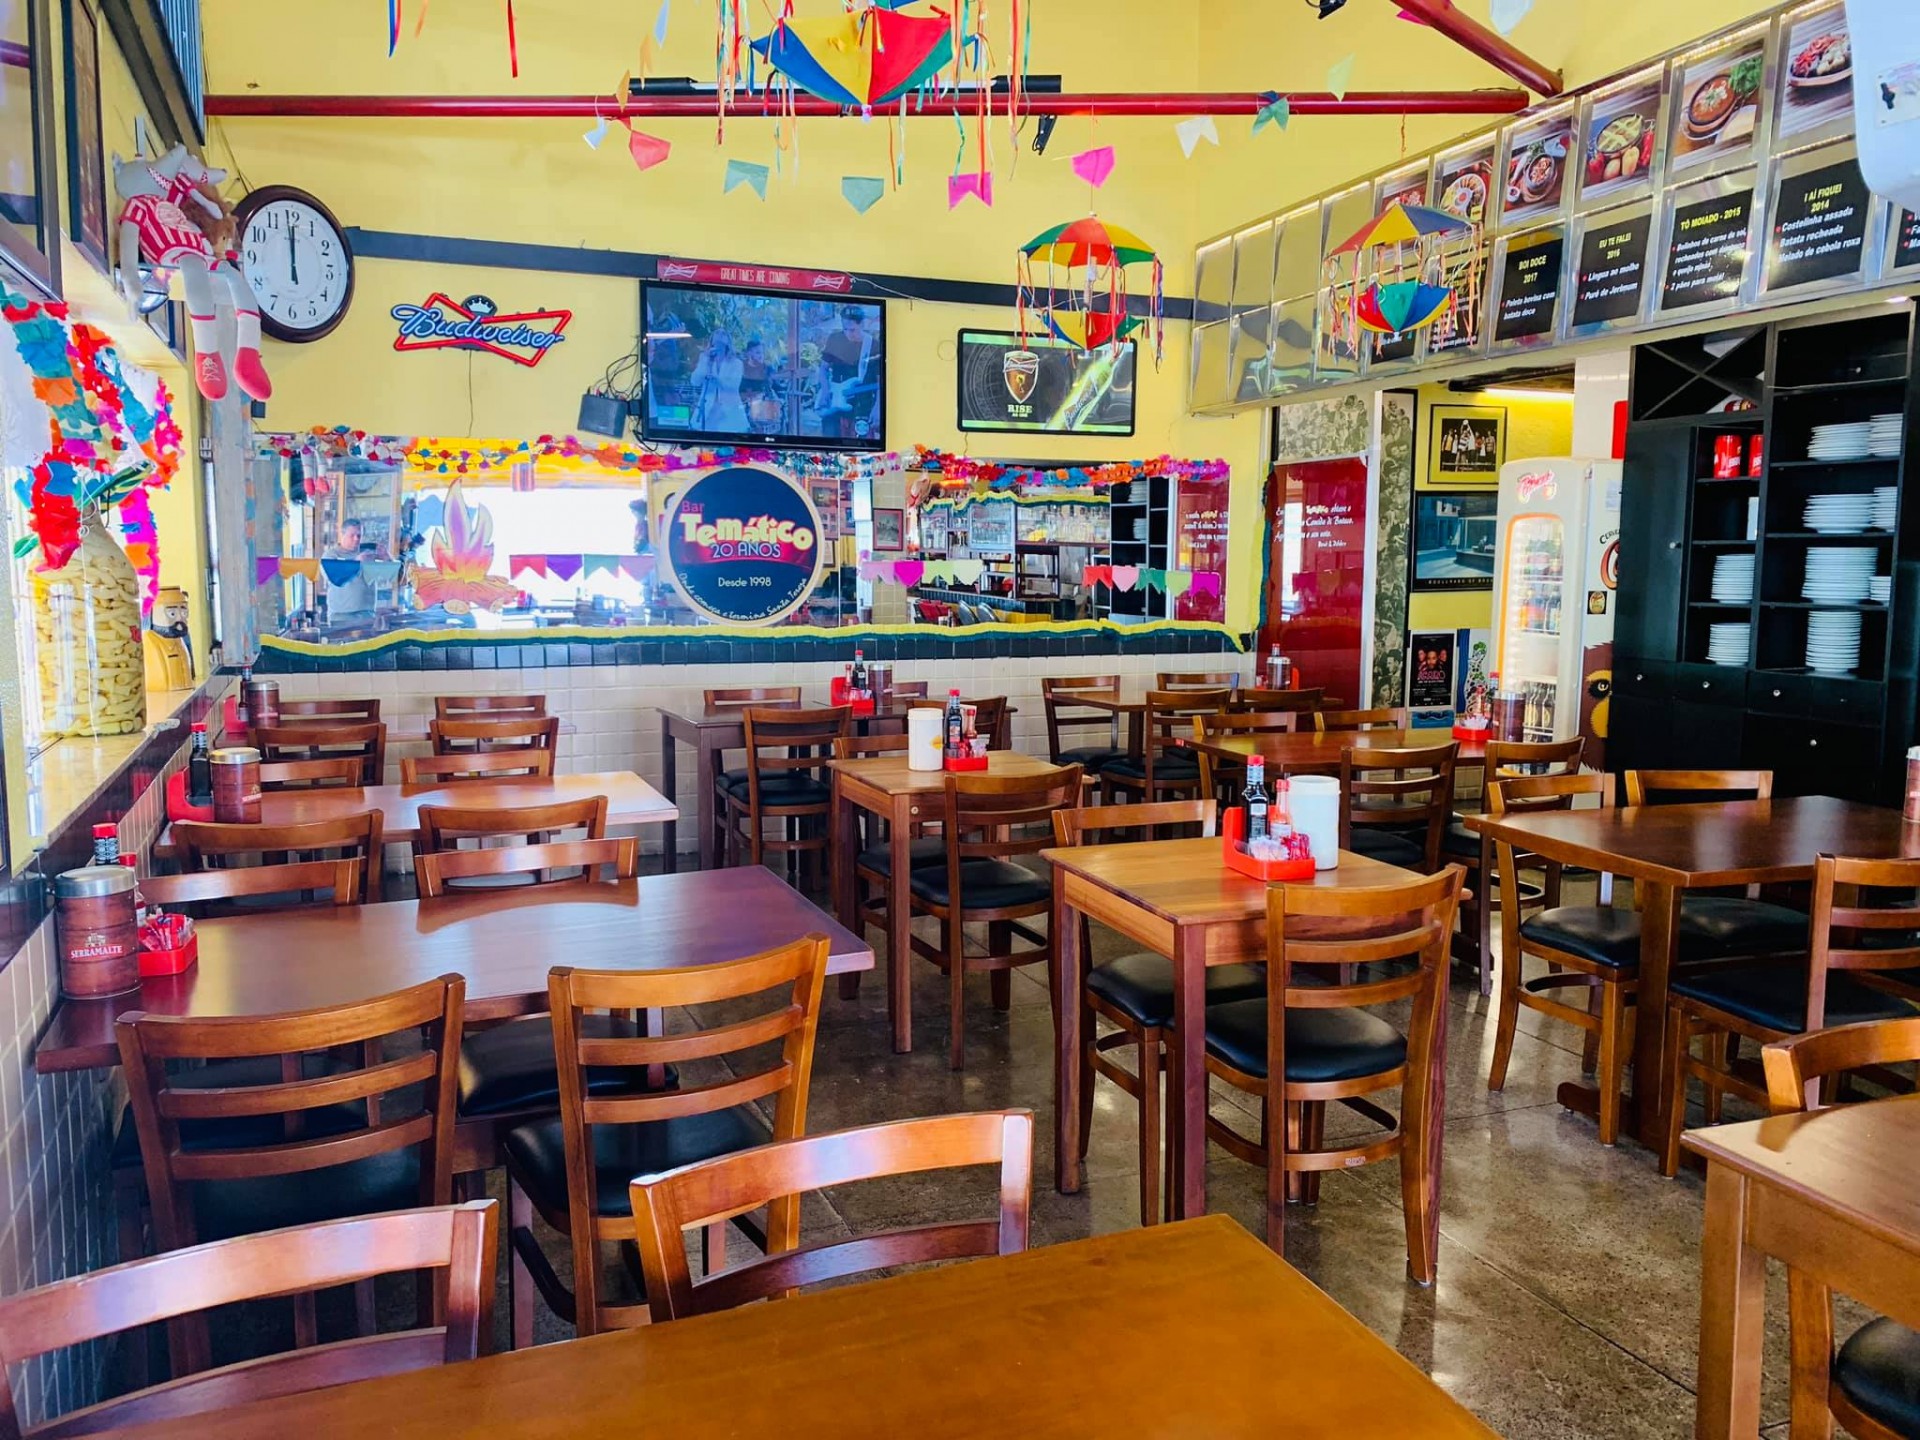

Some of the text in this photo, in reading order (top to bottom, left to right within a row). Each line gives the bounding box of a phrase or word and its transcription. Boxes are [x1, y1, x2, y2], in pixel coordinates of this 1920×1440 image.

[1818, 183, 1842, 198] FIQUEI
[1811, 199, 1830, 213] 2014
[268, 211, 278, 229] 11
[1691, 213, 1719, 228] MOIADO
[1724, 207, 1741, 219] 2015
[1782, 206, 1854, 232] Costelinha assada
[252, 226, 266, 243] 10
[1780, 225, 1843, 247] Batata recheada
[322, 240, 330, 256] 2
[1805, 247, 1814, 256] de
[1815, 241, 1841, 255] cebola
[1842, 237, 1861, 248] roxa
[248, 250, 257, 265] 9
[1530, 255, 1547, 268] DOCE
[326, 263, 333, 281] 3
[721, 268, 736, 280] GREAT
[739, 269, 754, 282] TIMES
[769, 271, 790, 285] COMING
[1523, 272, 1538, 284] 2017
[270, 294, 278, 310] 7
[320, 286, 327, 302] 4
[1542, 291, 1556, 300] com
[289, 303, 297, 320] 6
[309, 301, 316, 317] 5
[1503, 308, 1536, 320] batata doce
[391, 304, 565, 348] Budweiser
[1008, 404, 1032, 413] RISE
[682, 501, 704, 512] Bar
[679, 513, 814, 550] Temático
[1600, 529, 1620, 544] CERVE
[711, 542, 781, 558] 20 ANOS
[718, 576, 771, 587] Desde 1998
[767, 598, 790, 615] Santa
[71, 946, 122, 959] SERRAMALTE
